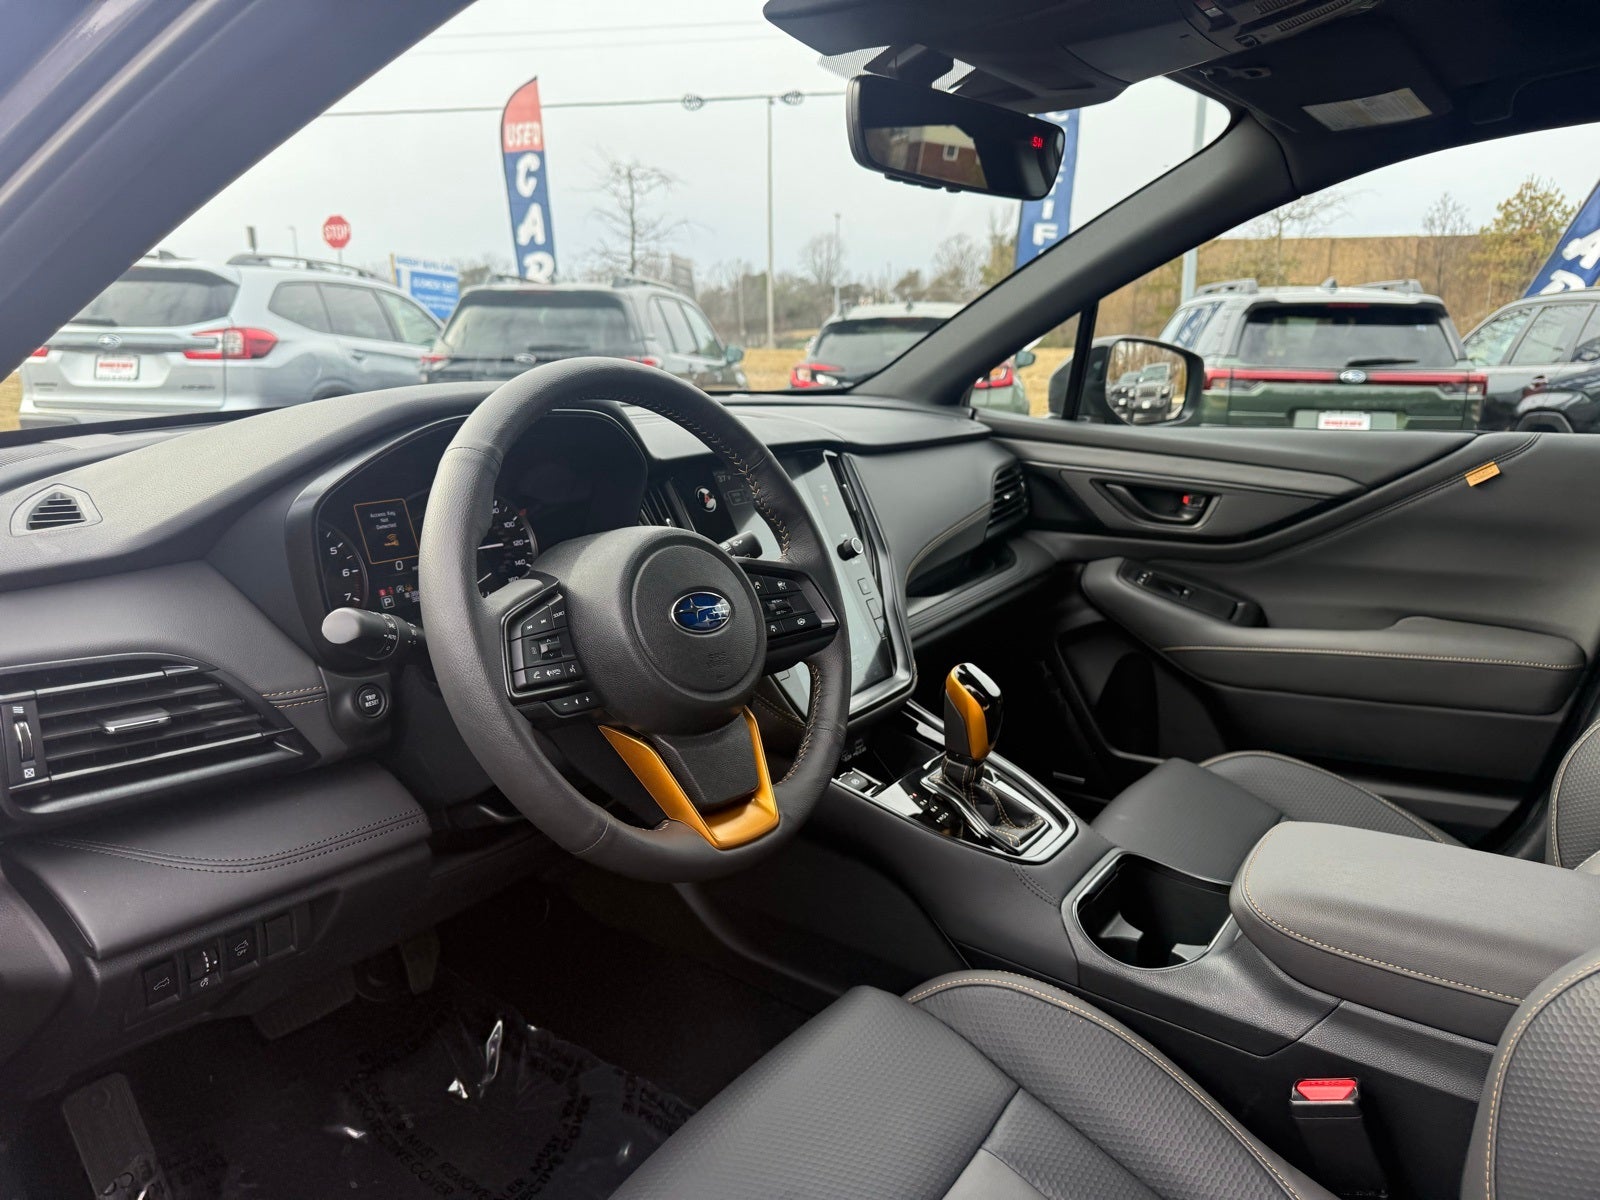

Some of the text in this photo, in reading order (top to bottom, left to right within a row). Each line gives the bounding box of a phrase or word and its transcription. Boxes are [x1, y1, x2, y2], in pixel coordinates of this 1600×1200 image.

[505, 121, 541, 147] USED
[324, 224, 350, 241] STOP
[329, 546, 338, 555] 5
[514, 558, 526, 566] 140
[342, 568, 350, 577] 6
[344, 593, 352, 601] 7
[383, 597, 392, 606] P
[365, 693, 376, 701] TRIP
[365, 699, 380, 708] RESET
